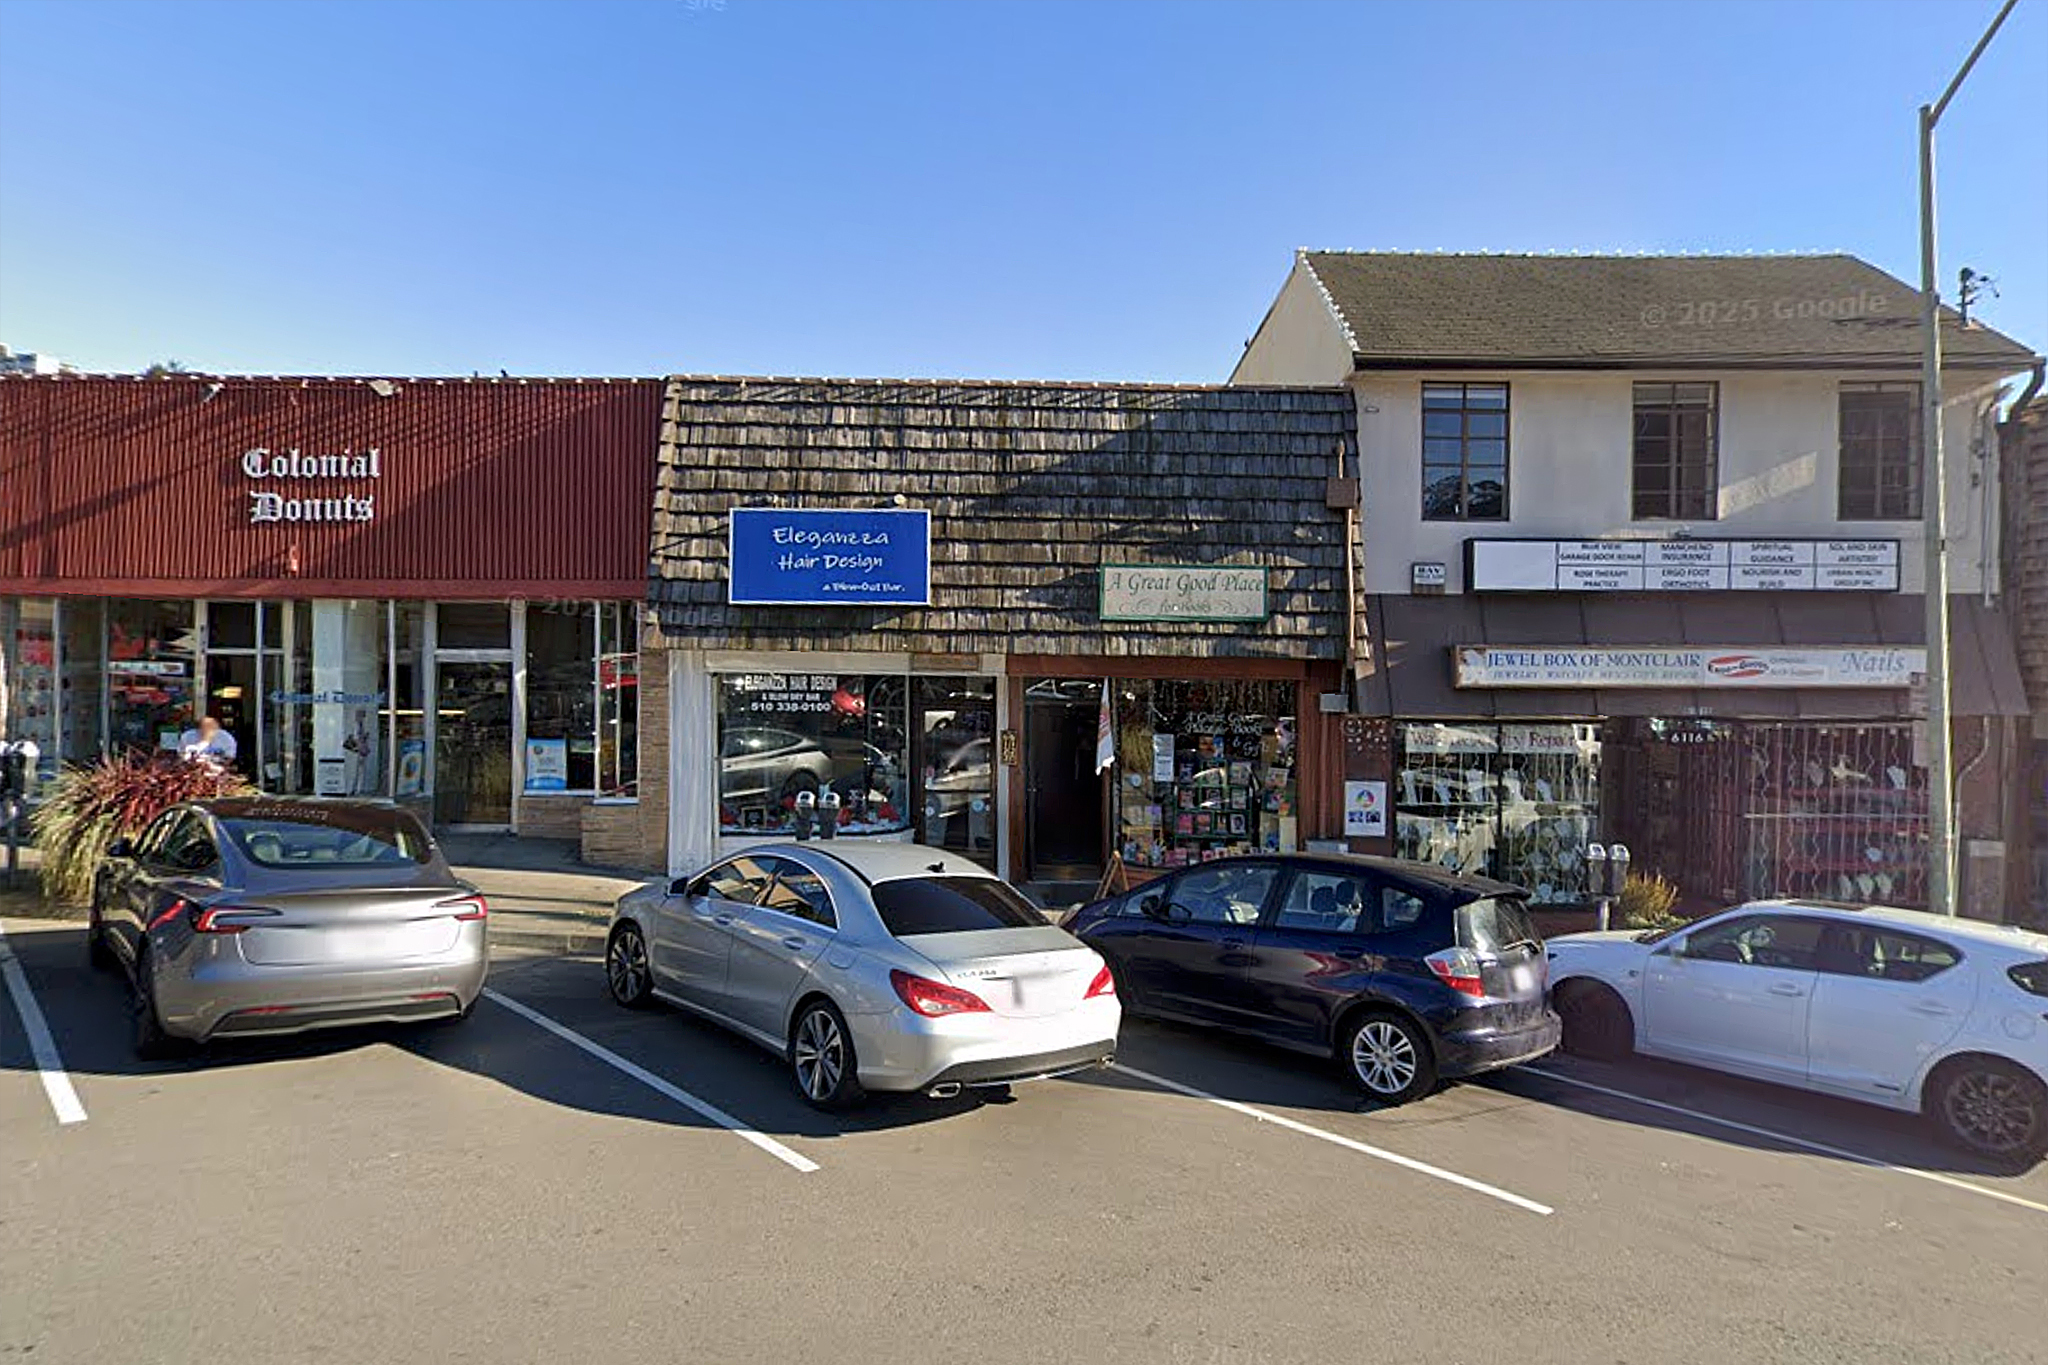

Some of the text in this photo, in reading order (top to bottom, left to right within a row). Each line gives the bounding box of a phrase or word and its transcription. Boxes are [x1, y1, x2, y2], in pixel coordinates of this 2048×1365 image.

[242, 448, 381, 478] Colonial
[249, 490, 374, 523] Donuts
[772, 526, 890, 549] Eleganzza
[1751, 543, 1793, 551] SPIRITUAL
[1560, 552, 1590, 560] GARAGE
[1661, 552, 1711, 561] INSURANCE
[1751, 555, 1794, 563] GUIDANCE
[778, 553, 883, 573] Hair Design
[1688, 569, 1710, 577] FOOT
[1783, 568, 1802, 576] AND
[1107, 572, 1263, 597] A Great Good Place
[1661, 580, 1711, 588] ORTHOTICS
[1486, 652, 1700, 668] JEWEL BOX OF MONTCLAIR
[1839, 650, 1906, 674] Nails
[810, 675, 838, 691] DESIGN
[806, 693, 821, 702] BAR
[751, 702, 774, 712] 510
[1671, 732, 1704, 744] 6116
